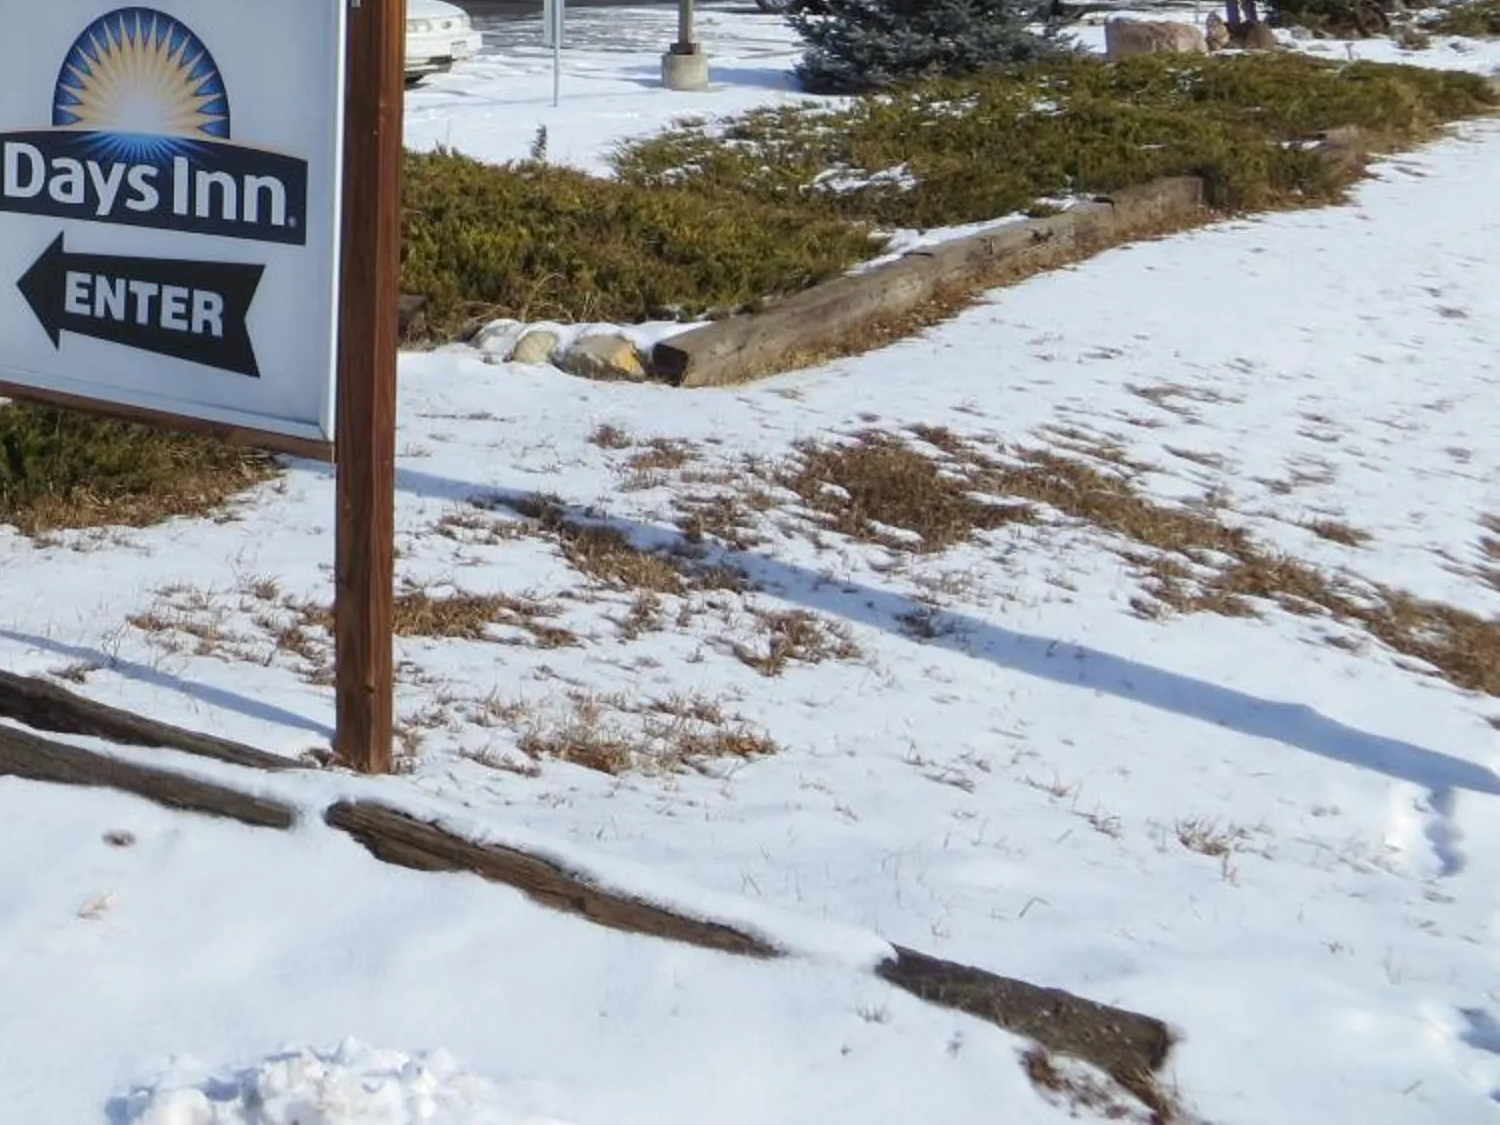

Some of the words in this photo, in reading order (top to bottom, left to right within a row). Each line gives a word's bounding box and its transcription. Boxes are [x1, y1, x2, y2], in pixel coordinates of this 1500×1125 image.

[2, 141, 160, 216] Days
[173, 156, 287, 228] Inn
[64, 271, 224, 339] ENTER
